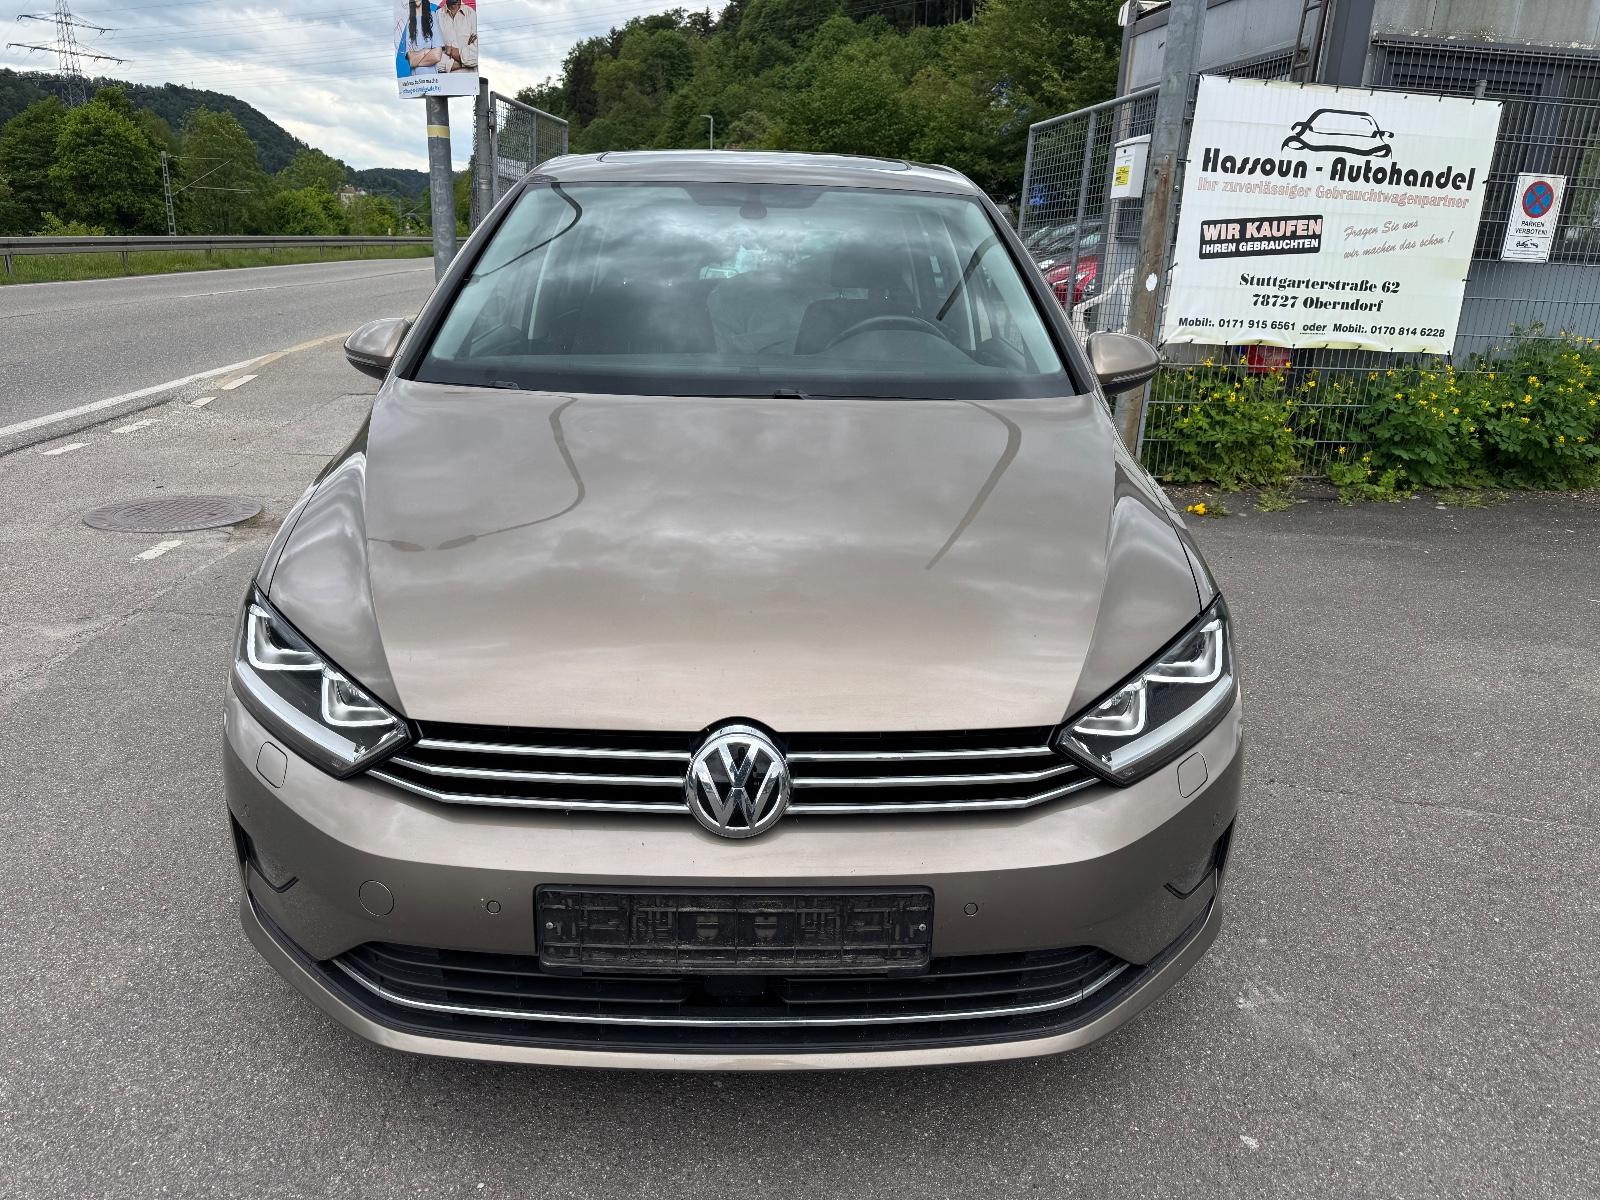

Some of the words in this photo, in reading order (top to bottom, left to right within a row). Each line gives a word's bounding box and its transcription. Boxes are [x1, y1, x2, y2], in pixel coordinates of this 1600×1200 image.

[1202, 148, 1307, 178] Hassoun
[1329, 156, 1476, 191] Autohandel
[1198, 177, 1218, 191] Ihr
[1222, 180, 1311, 199] zuverlässiger
[1315, 184, 1470, 208] Gebrauchtwagenpartner
[1202, 223, 1240, 241] WIR
[1245, 219, 1322, 239] KAUFEN
[1344, 225, 1379, 240] Fragen
[1381, 220, 1400, 234] Sie
[1402, 220, 1418, 230] uns
[1521, 220, 1545, 228] PARKEN
[1202, 242, 1236, 254] IHREN
[1238, 238, 1319, 252] GEBRAUCHTEN
[1343, 249, 1360, 259] wir
[1362, 240, 1397, 256] machen
[1399, 237, 1417, 250] das
[1239, 272, 1377, 293] Stuttgarterstraße
[1381, 280, 1400, 294] 62
[1252, 293, 1299, 309] 78727
[1302, 296, 1383, 312] Oberndorf
[1218, 319, 1244, 329] 0171
[1247, 319, 1268, 329] 915
[1270, 320, 1296, 331] 6561
[1302, 322, 1327, 332] oder
[1370, 325, 1396, 336] 0170
[1398, 327, 1417, 336] 814
[1420, 327, 1445, 337] 6228
[692, 738, 784, 832] VW
